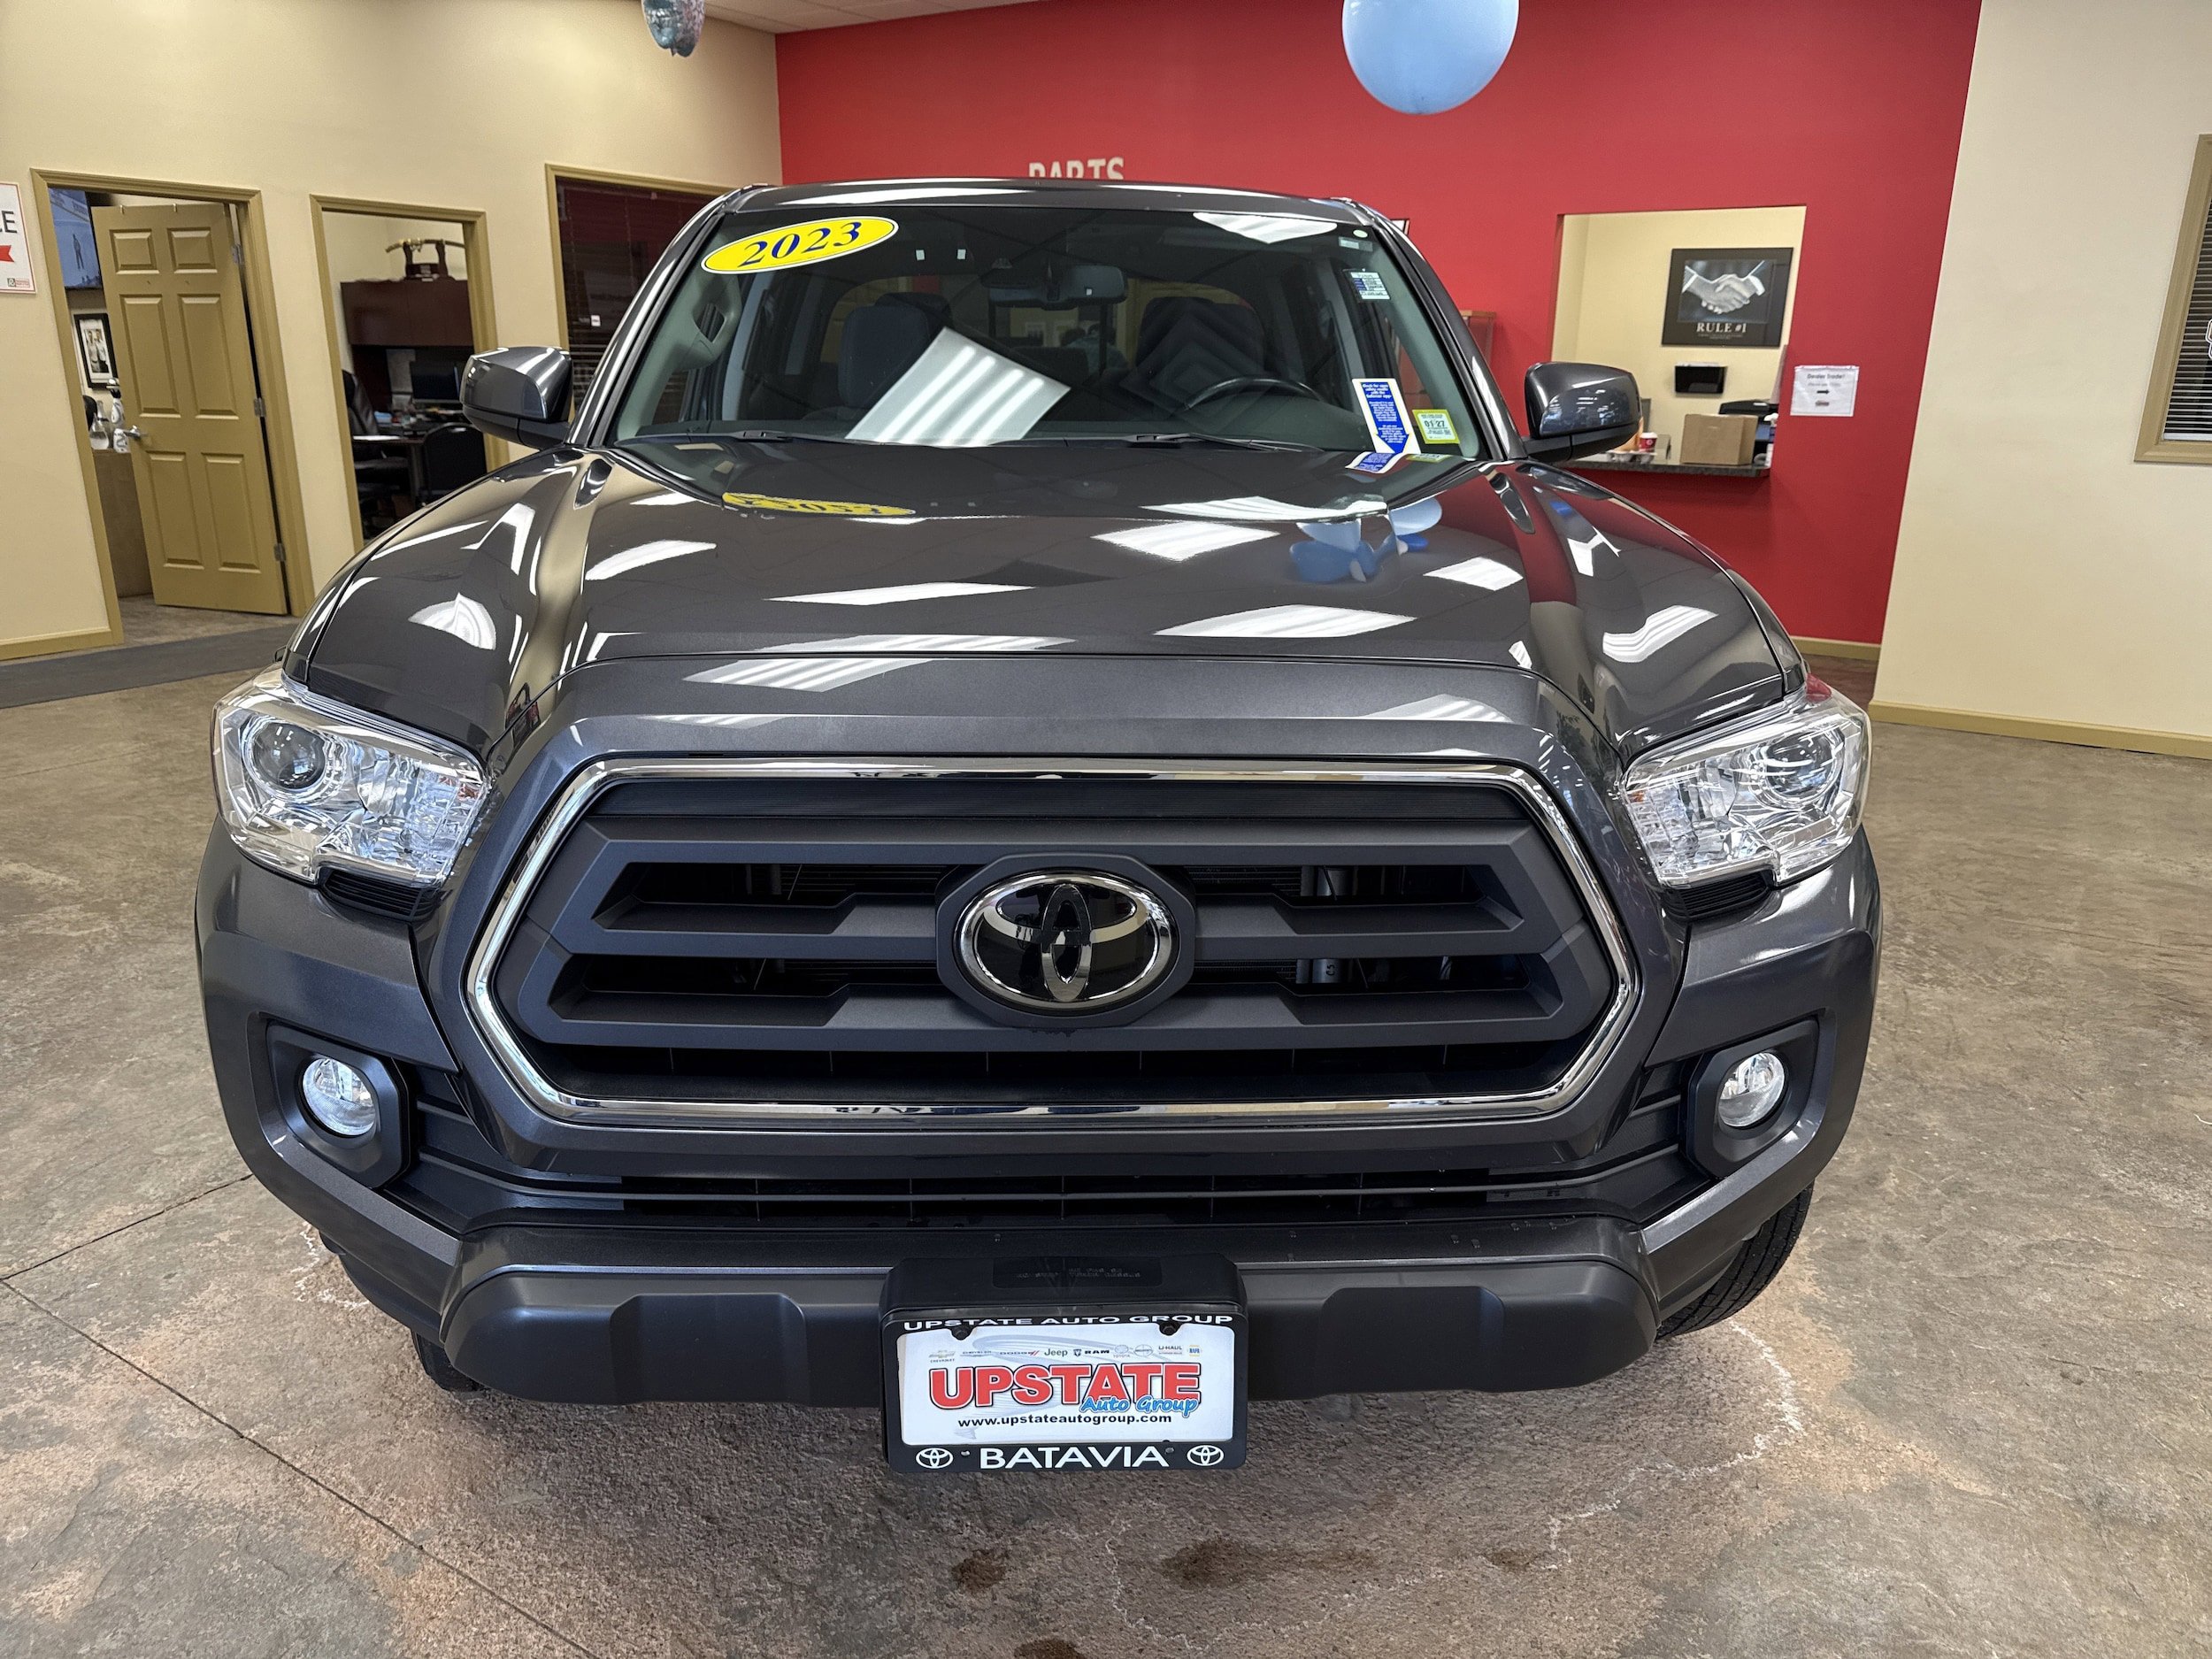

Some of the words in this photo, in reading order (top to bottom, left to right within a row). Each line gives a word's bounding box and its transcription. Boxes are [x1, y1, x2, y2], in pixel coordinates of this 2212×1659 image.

[0, 210, 18, 234] E
[737, 221, 863, 268] 2023
[1696, 322, 1732, 333] RULE
[903, 1317, 1033, 1331] UPSTATE
[1040, 1316, 1120, 1325] AUTO
[1131, 1315, 1233, 1325] GROUP
[1044, 1348, 1068, 1357] Jeep
[929, 1363, 1202, 1409] UPSTATE
[1079, 1395, 1131, 1414] Auto
[1135, 1395, 1200, 1419] Group
[957, 1413, 1172, 1428] www.upstateautogroup.com
[979, 1446, 1170, 1469] BATAVIA
